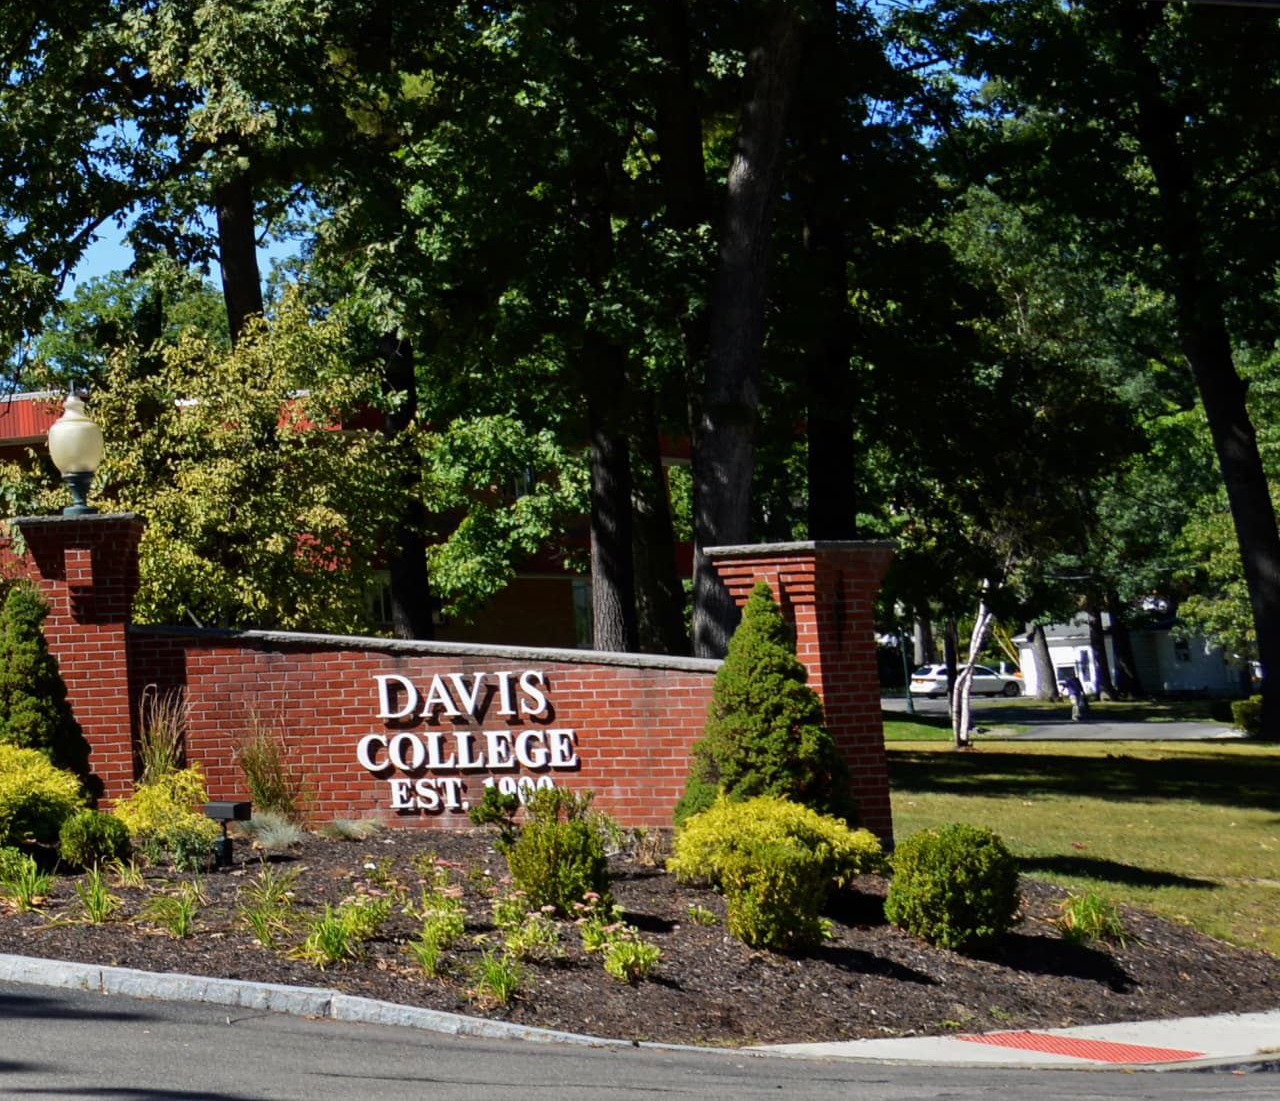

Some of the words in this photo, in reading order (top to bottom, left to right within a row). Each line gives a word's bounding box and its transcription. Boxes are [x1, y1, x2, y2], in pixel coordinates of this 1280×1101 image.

[373, 670, 545, 718] DAVIS
[356, 729, 578, 771] COLLEGE
[388, 777, 470, 810] EST.
